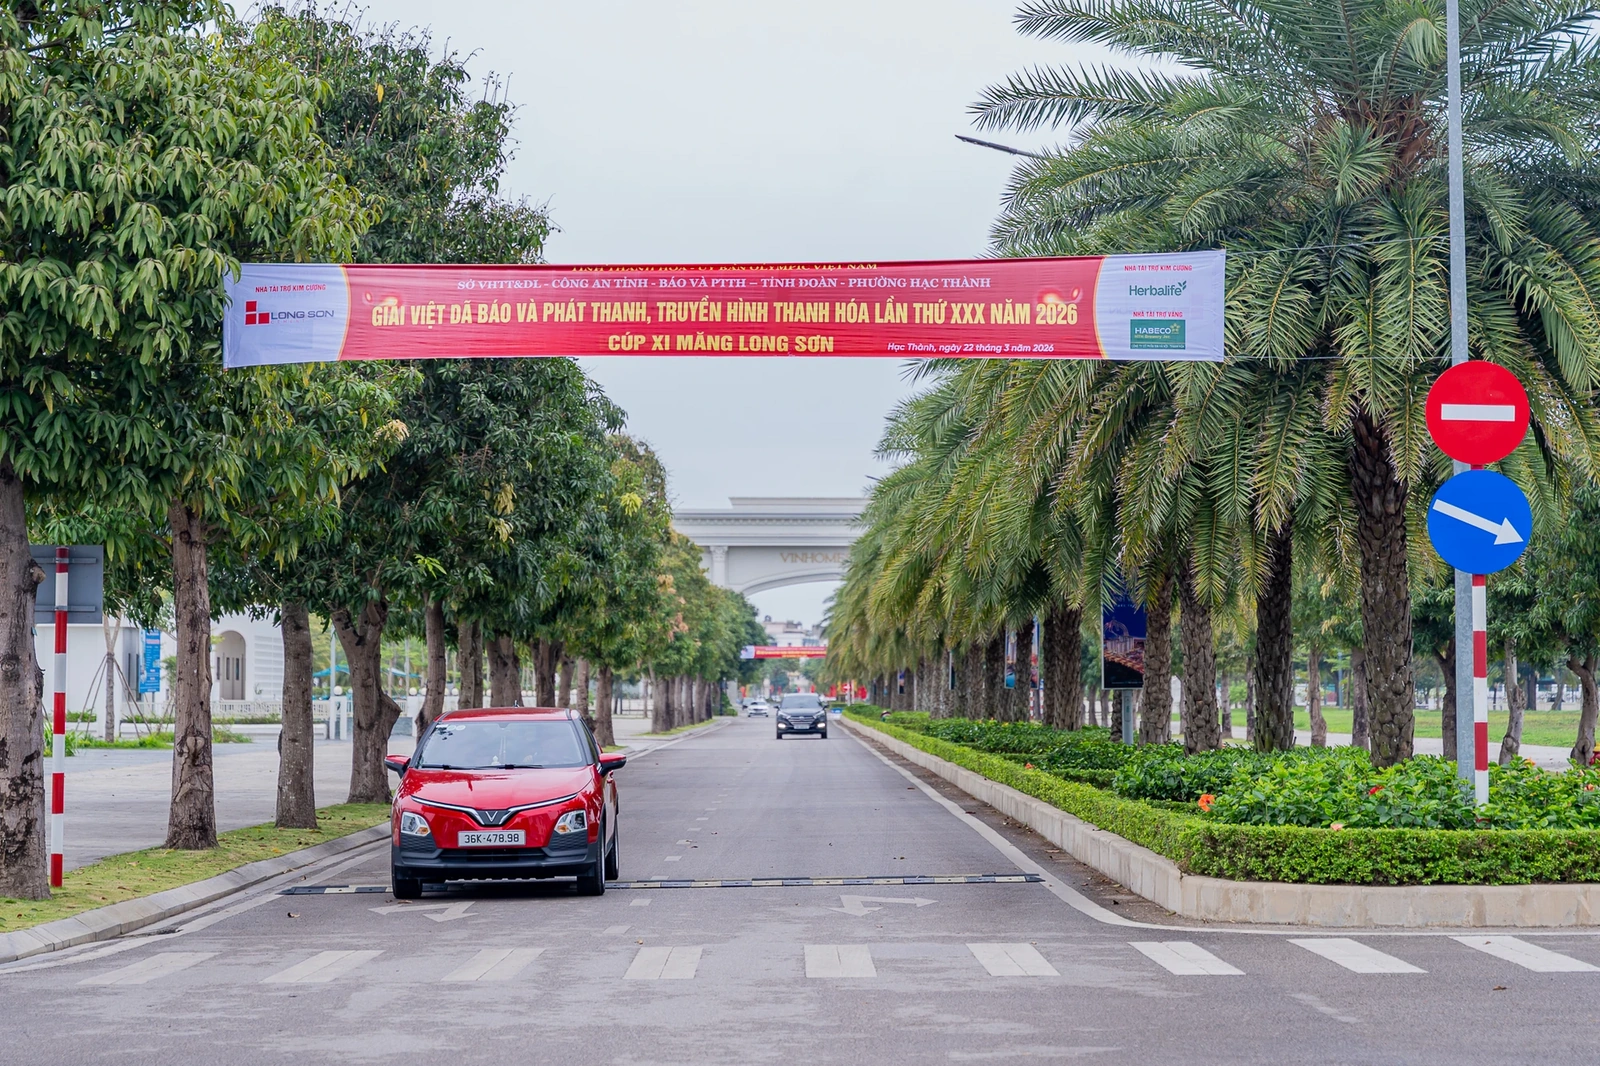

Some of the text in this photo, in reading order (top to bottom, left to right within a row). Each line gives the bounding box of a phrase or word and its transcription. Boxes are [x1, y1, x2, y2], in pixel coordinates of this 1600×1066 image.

[457, 279, 475, 290] SỞ
[478, 280, 542, 290] VHTT&DL
[552, 276, 589, 289] CÔNG
[592, 279, 611, 289] AN
[614, 277, 648, 289] TỈNH
[659, 276, 687, 288] BÁO
[690, 276, 708, 288] VÀ
[711, 279, 746, 288] PTTH
[761, 276, 796, 288] TỈNH
[798, 276, 838, 288] ĐOÀN
[848, 276, 908, 288] PHƯỜNG
[910, 278, 939, 290] HẠC
[942, 276, 991, 288] THÀNH
[1129, 285, 1182, 296] Herbalife
[271, 311, 305, 320] LONG
[411, 300, 446, 329] VIỆT
[450, 299, 473, 324] DÃ
[477, 299, 512, 324] BÁO
[516, 298, 538, 323] VÀ
[543, 298, 587, 322] PHÁT
[591, 302, 651, 324] THANH,
[656, 295, 722, 323] TRUYỀN
[726, 298, 768, 322] HÌNH
[773, 302, 830, 323] THANH
[835, 298, 870, 323] HÓA
[874, 296, 908, 324] LẦN
[912, 298, 948, 324] THỨ
[950, 303, 985, 325] XXX
[990, 298, 1031, 325] NĂM
[1035, 303, 1078, 325] 2026
[608, 332, 834, 352] CÚP XI MĂNG LONG SƠN
[887, 343, 906, 351] Hạc
[907, 343, 937, 352] Thành,
[938, 343, 962, 353] ngày
[975, 343, 1003, 354] tháng
[1003, 343, 1010, 352] 3
[1011, 344, 1031, 352] năm
[1032, 344, 1054, 352] 2026
[464, 833, 520, 843] 36K-478.98
